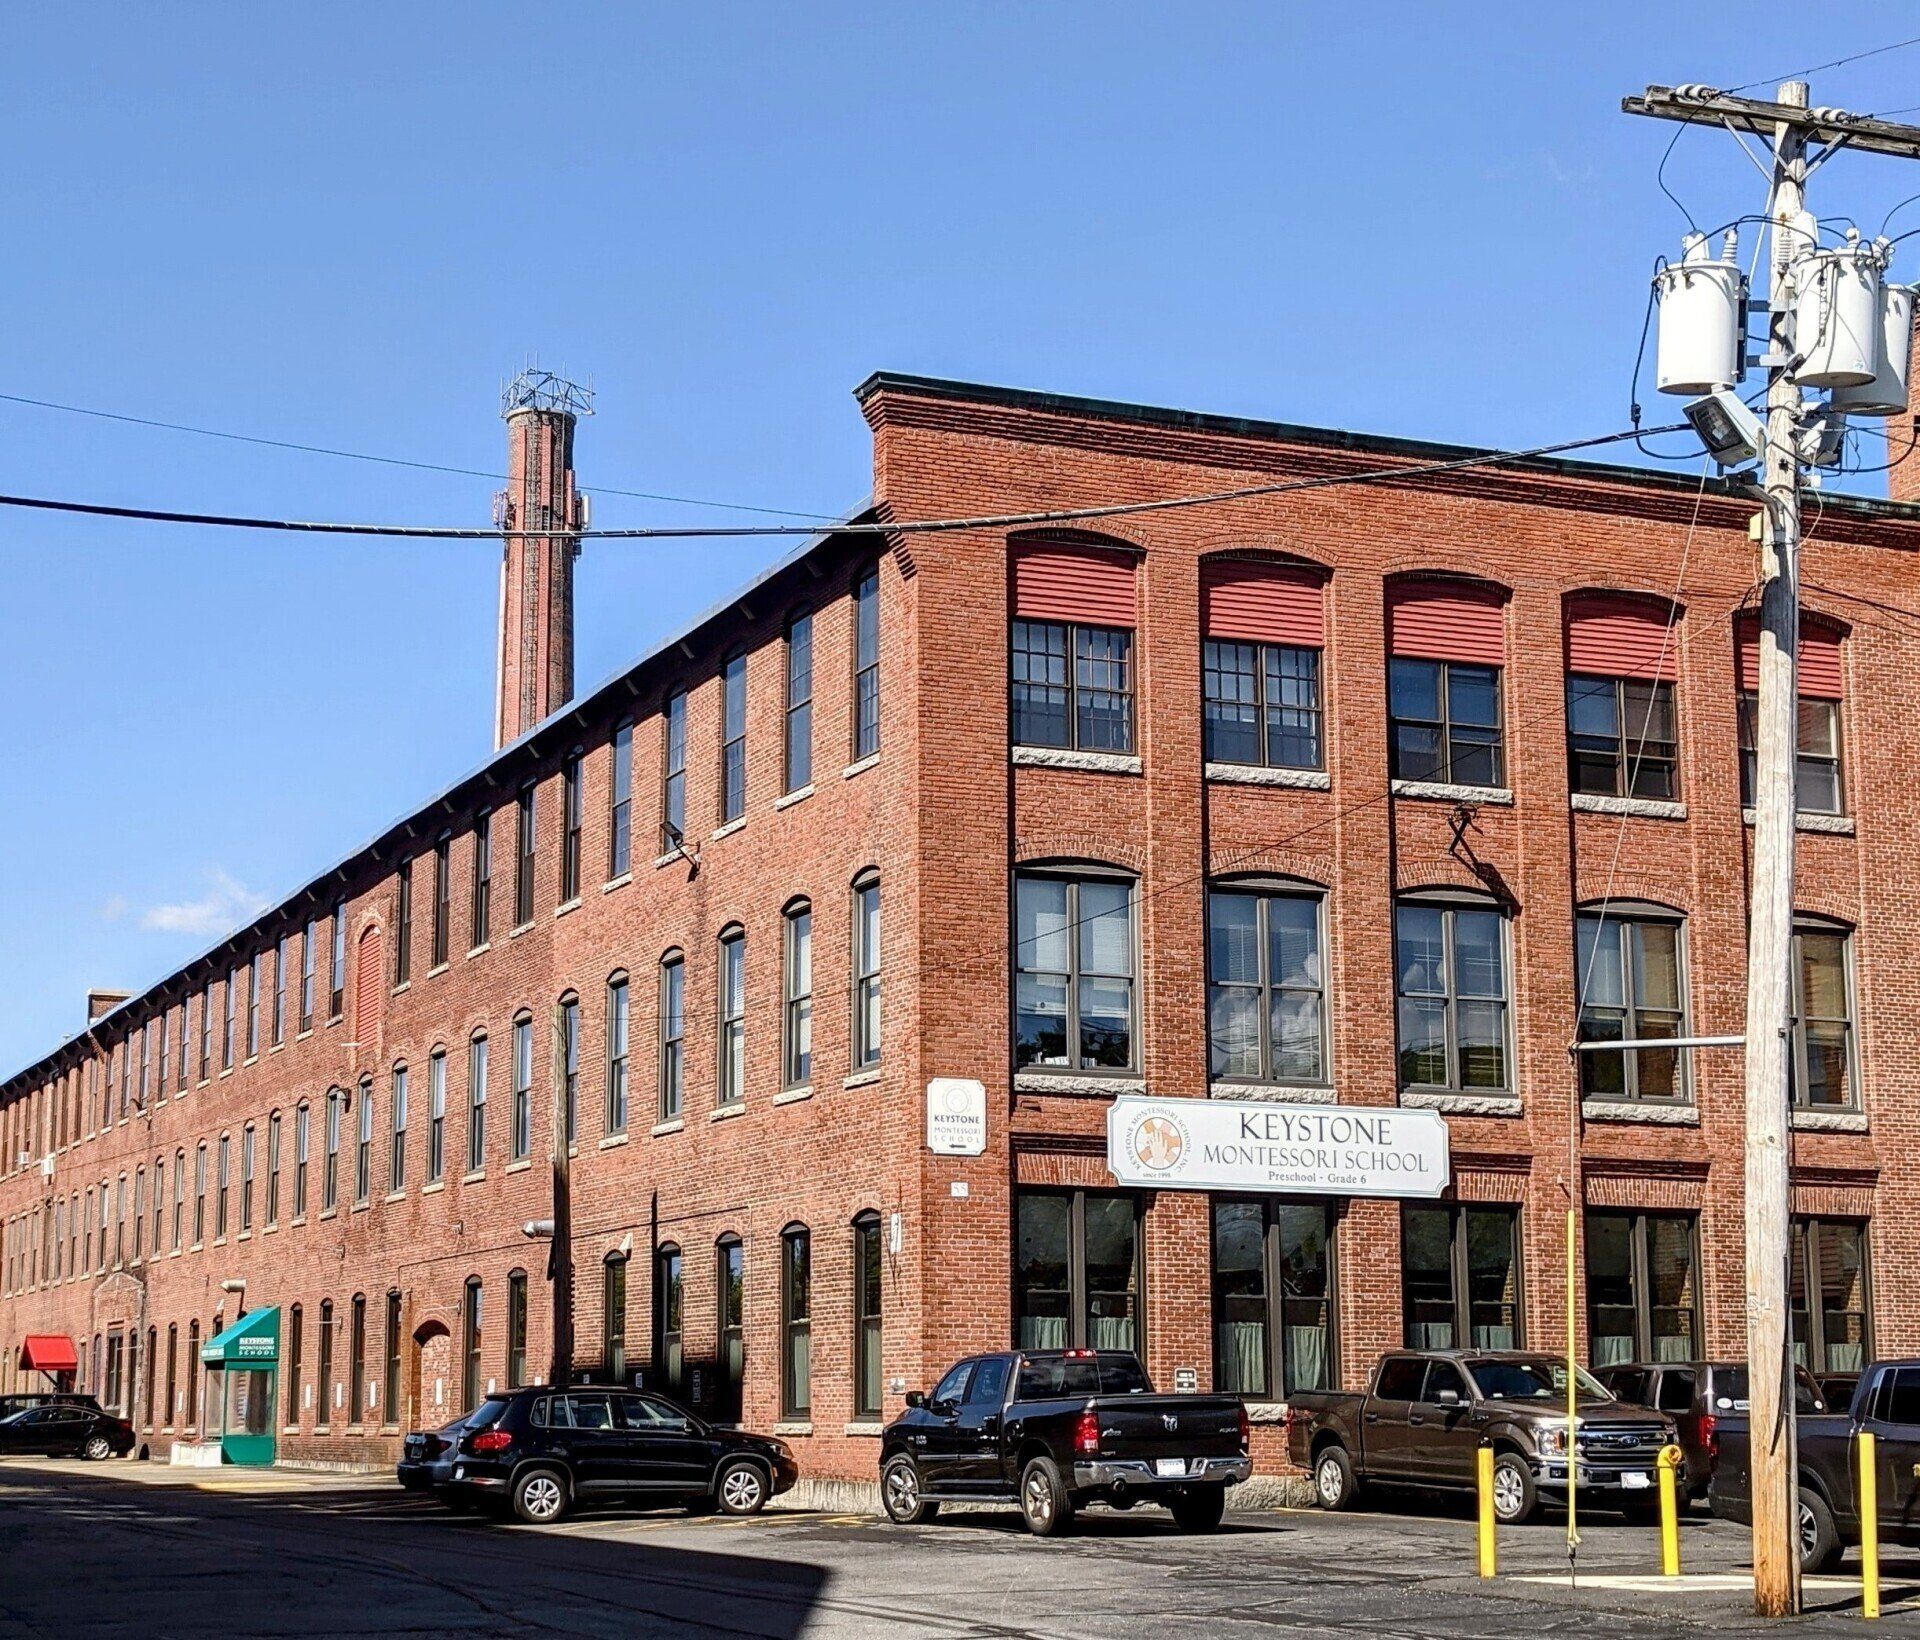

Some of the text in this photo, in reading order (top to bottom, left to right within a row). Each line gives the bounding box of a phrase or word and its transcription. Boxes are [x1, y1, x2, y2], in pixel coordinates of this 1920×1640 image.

[934, 1114, 980, 1124] KEYSTONE
[934, 1126, 981, 1135] MONTESSORI
[1240, 1112, 1392, 1146] KEYSTONE
[934, 1135, 980, 1143] SCHOOL
[1203, 1144, 1429, 1173] MONTESSORI SCHOOL
[1268, 1171, 1316, 1183] Preschool
[1327, 1173, 1357, 1184] Grade
[1360, 1174, 1367, 1185] 6
[239, 1337, 275, 1345] KEYSTONE
